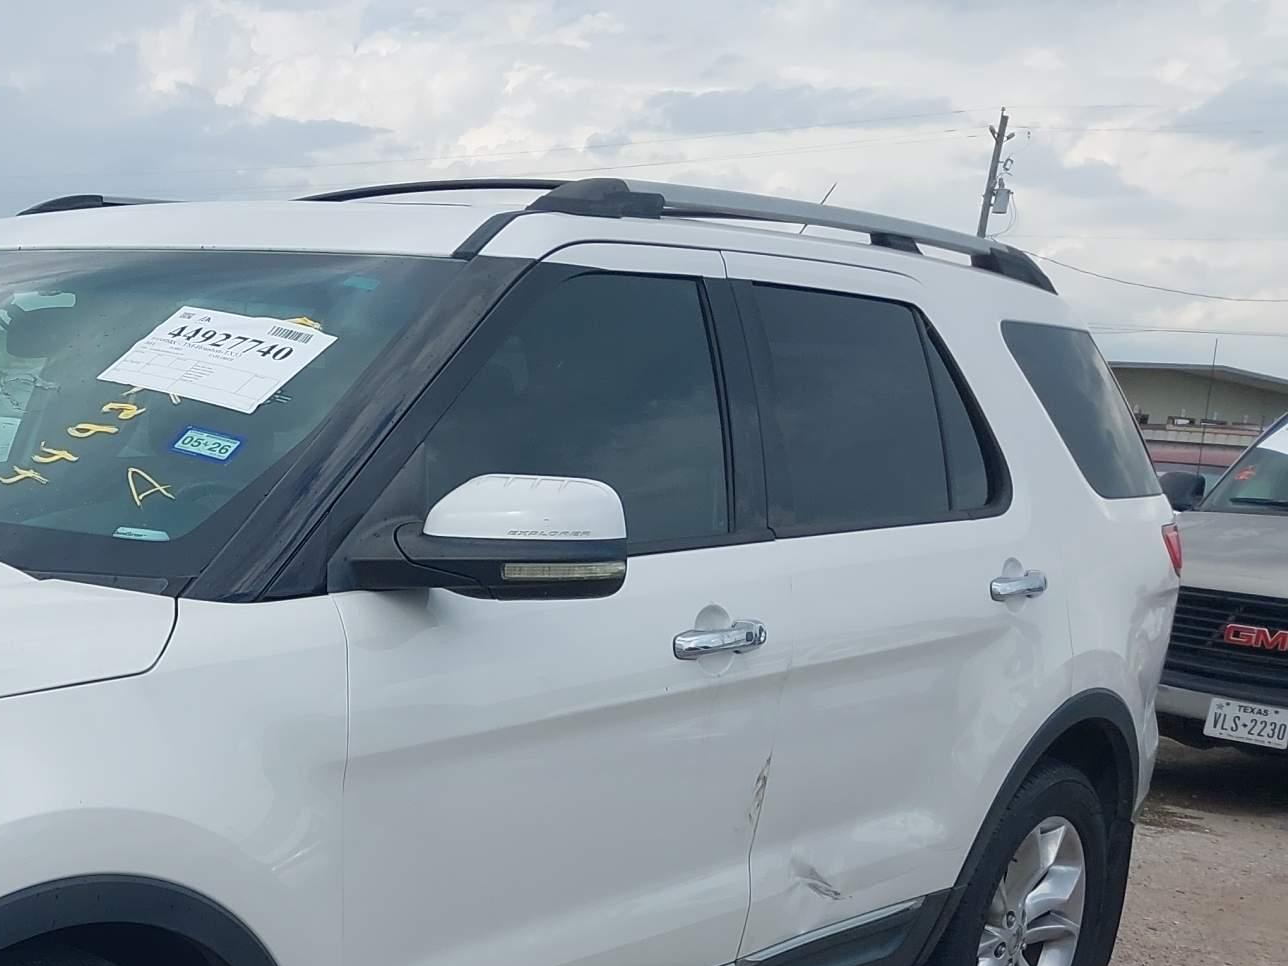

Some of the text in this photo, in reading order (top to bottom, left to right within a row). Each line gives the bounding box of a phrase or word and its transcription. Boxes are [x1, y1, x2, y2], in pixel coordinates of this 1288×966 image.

[167, 325, 294, 361] 44927740
[1224, 623, 1288, 651] GM
[1238, 704, 1269, 717] TEXAS
